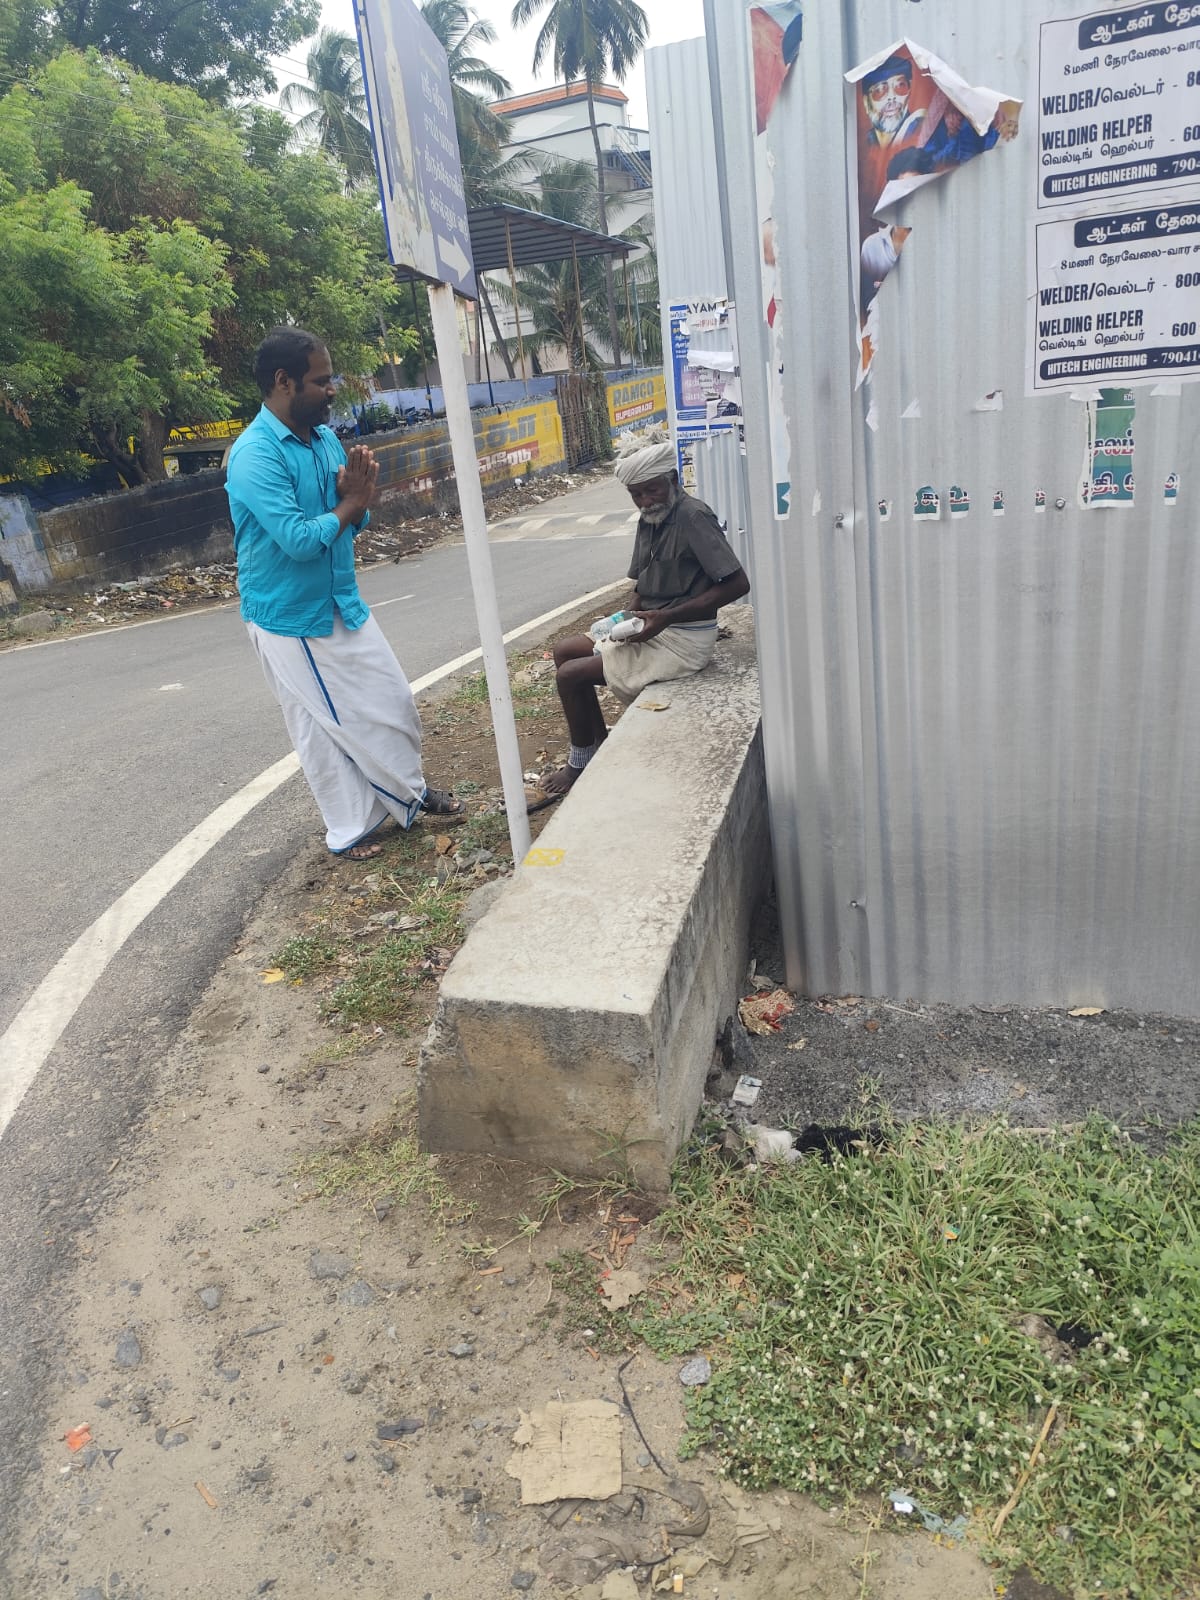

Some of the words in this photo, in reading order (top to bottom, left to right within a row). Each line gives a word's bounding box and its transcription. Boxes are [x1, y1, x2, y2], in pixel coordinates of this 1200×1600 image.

[1090, 10, 1155, 43] ஆட்கள்
[1042, 123, 1097, 151] WELDING
[1102, 113, 1152, 141] HELPER
[1041, 148, 1092, 166] வெல்டிங்
[1100, 136, 1155, 159] ஹெல்பர்
[1051, 174, 1086, 193] HITECH
[1088, 163, 1157, 187] ENGINEERING
[1086, 216, 1147, 243] ஆட்கள்
[1039, 315, 1092, 337] WELDING
[1096, 309, 1143, 331] HELPER
[1039, 336, 1087, 351] வெல்டிங்
[1094, 329, 1144, 347] ஹெல்பர்
[1172, 321, 1196, 337] 600
[1047, 360, 1079, 375] HITECH
[1081, 353, 1147, 371] ENGINEERING
[1161, 350, 1200, 364] 79041
[613, 379, 654, 407] RAMCO
